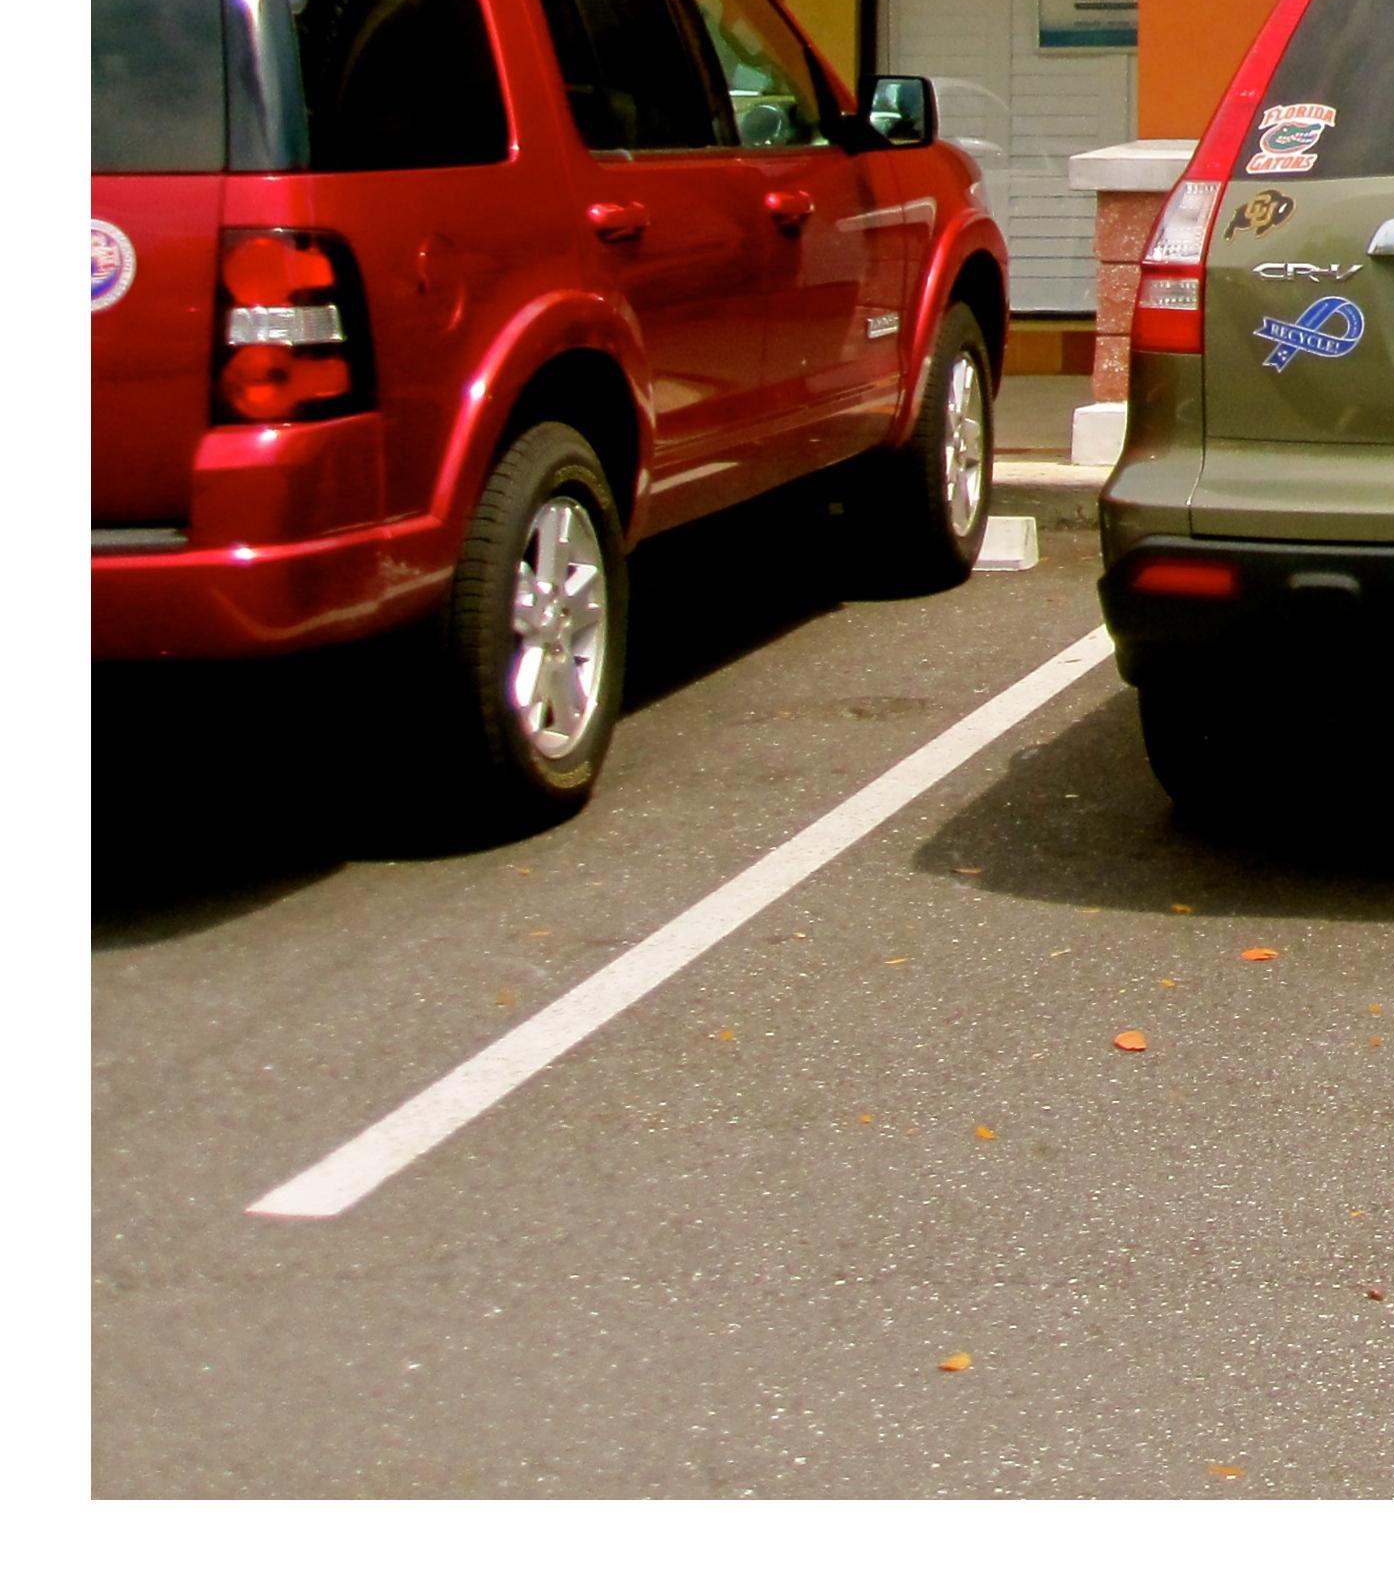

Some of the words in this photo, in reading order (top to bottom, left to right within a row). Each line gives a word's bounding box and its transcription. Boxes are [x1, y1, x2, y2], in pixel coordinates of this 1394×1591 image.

[1264, 105, 1335, 126] FLORIDA
[1247, 154, 1316, 172] GATORS
[1269, 323, 1342, 355] RECYCLE!
